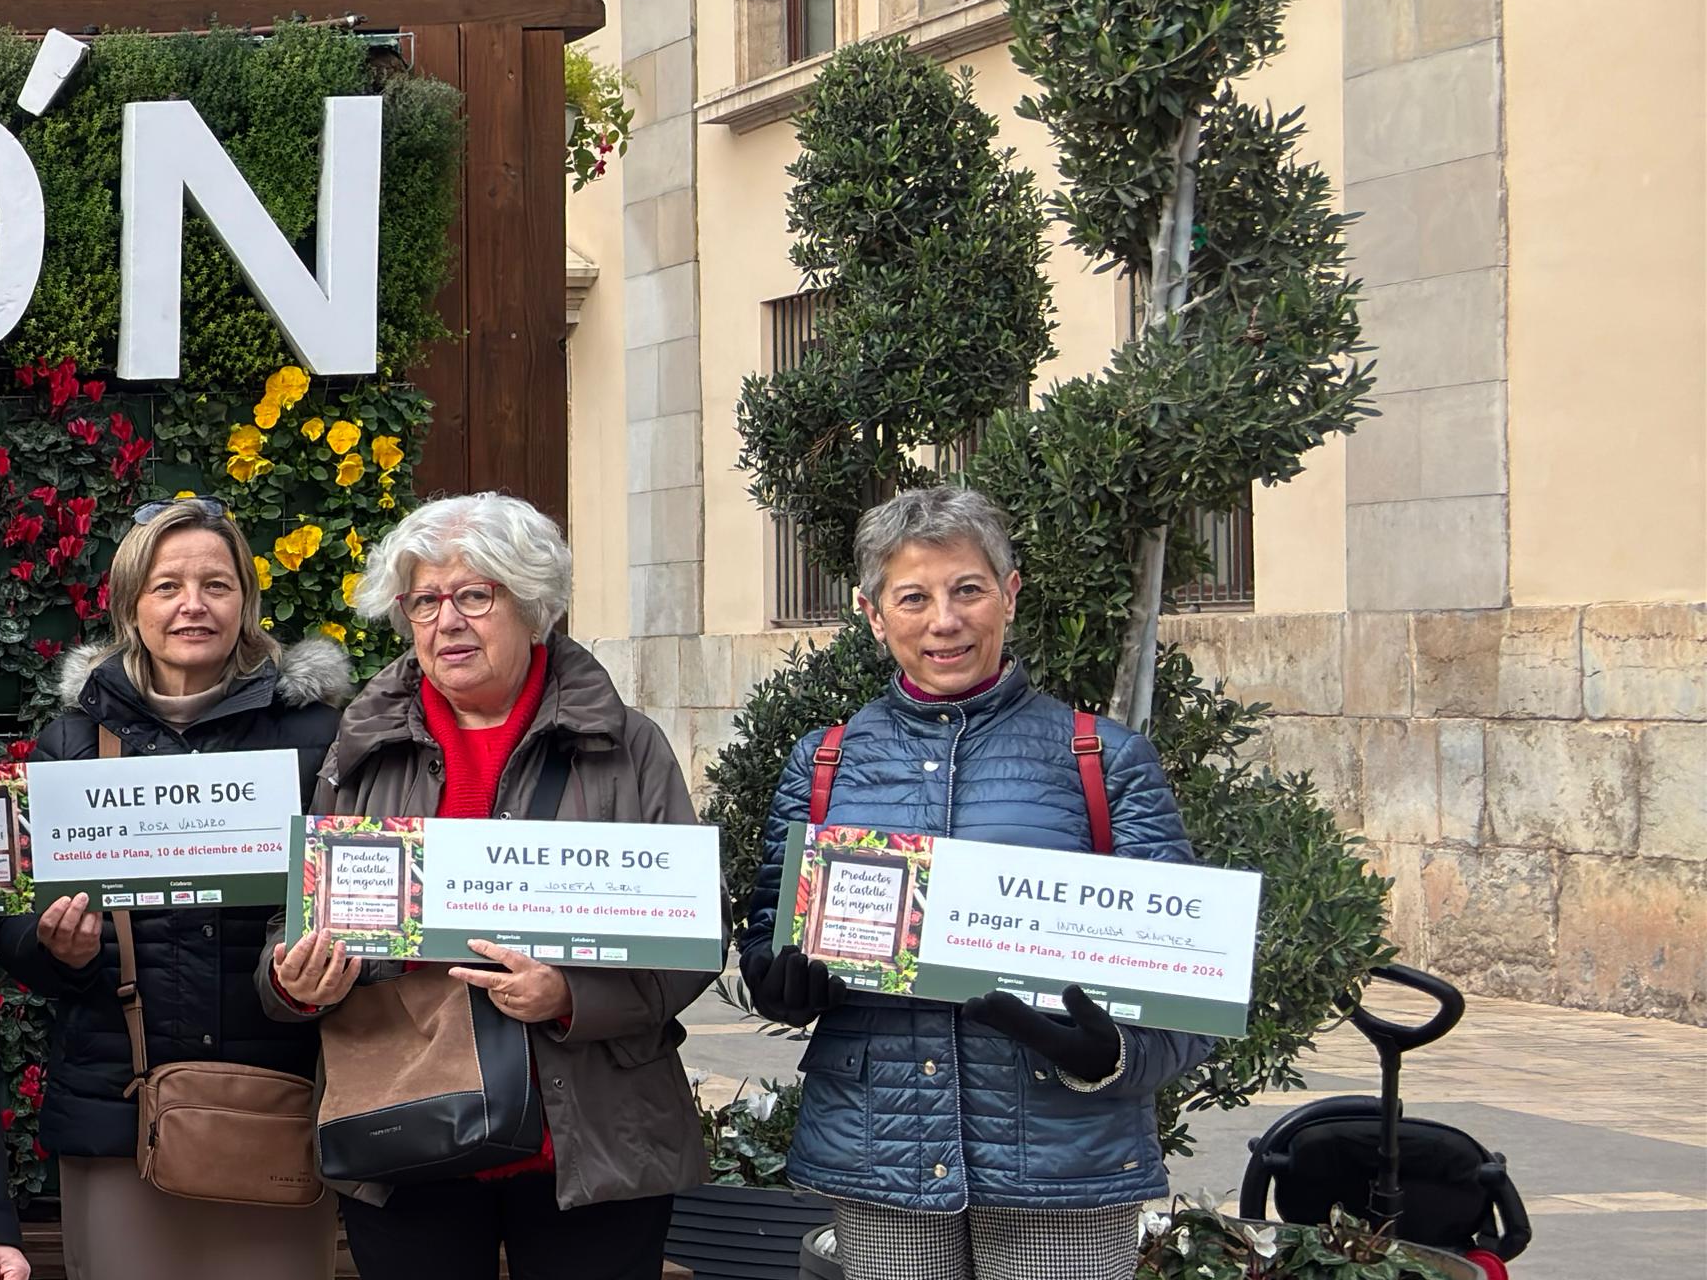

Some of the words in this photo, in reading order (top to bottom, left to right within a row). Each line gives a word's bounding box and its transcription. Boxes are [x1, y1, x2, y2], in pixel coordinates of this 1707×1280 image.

[84, 786, 145, 808] VALE
[154, 784, 201, 805] POR
[210, 781, 256, 803] 50€
[51, 828, 60, 839] a
[67, 825, 113, 842] pagar
[118, 825, 127, 836] a
[139, 821, 169, 832] ROSA
[485, 845, 549, 865] VALE
[561, 848, 610, 867] POR
[621, 850, 670, 869] 50€
[445, 879, 455, 889] a
[463, 880, 513, 894] pagar
[518, 881, 528, 892] a
[997, 875, 1068, 903] VALE
[1078, 884, 1133, 911] POR
[1145, 892, 1202, 919] 50€
[949, 909, 959, 921] a
[967, 912, 1023, 930] pagar
[1028, 919, 1039, 931] a
[946, 934, 993, 949] Castelló
[996, 940, 1011, 951] de
[1014, 942, 1025, 953] la
[1029, 944, 1065, 959] Plana,
[1070, 949, 1086, 960] 10
[1089, 952, 1104, 963] de
[1107, 954, 1168, 971] diciembre
[1172, 962, 1187, 973] de
[1191, 964, 1223, 977] 2024
